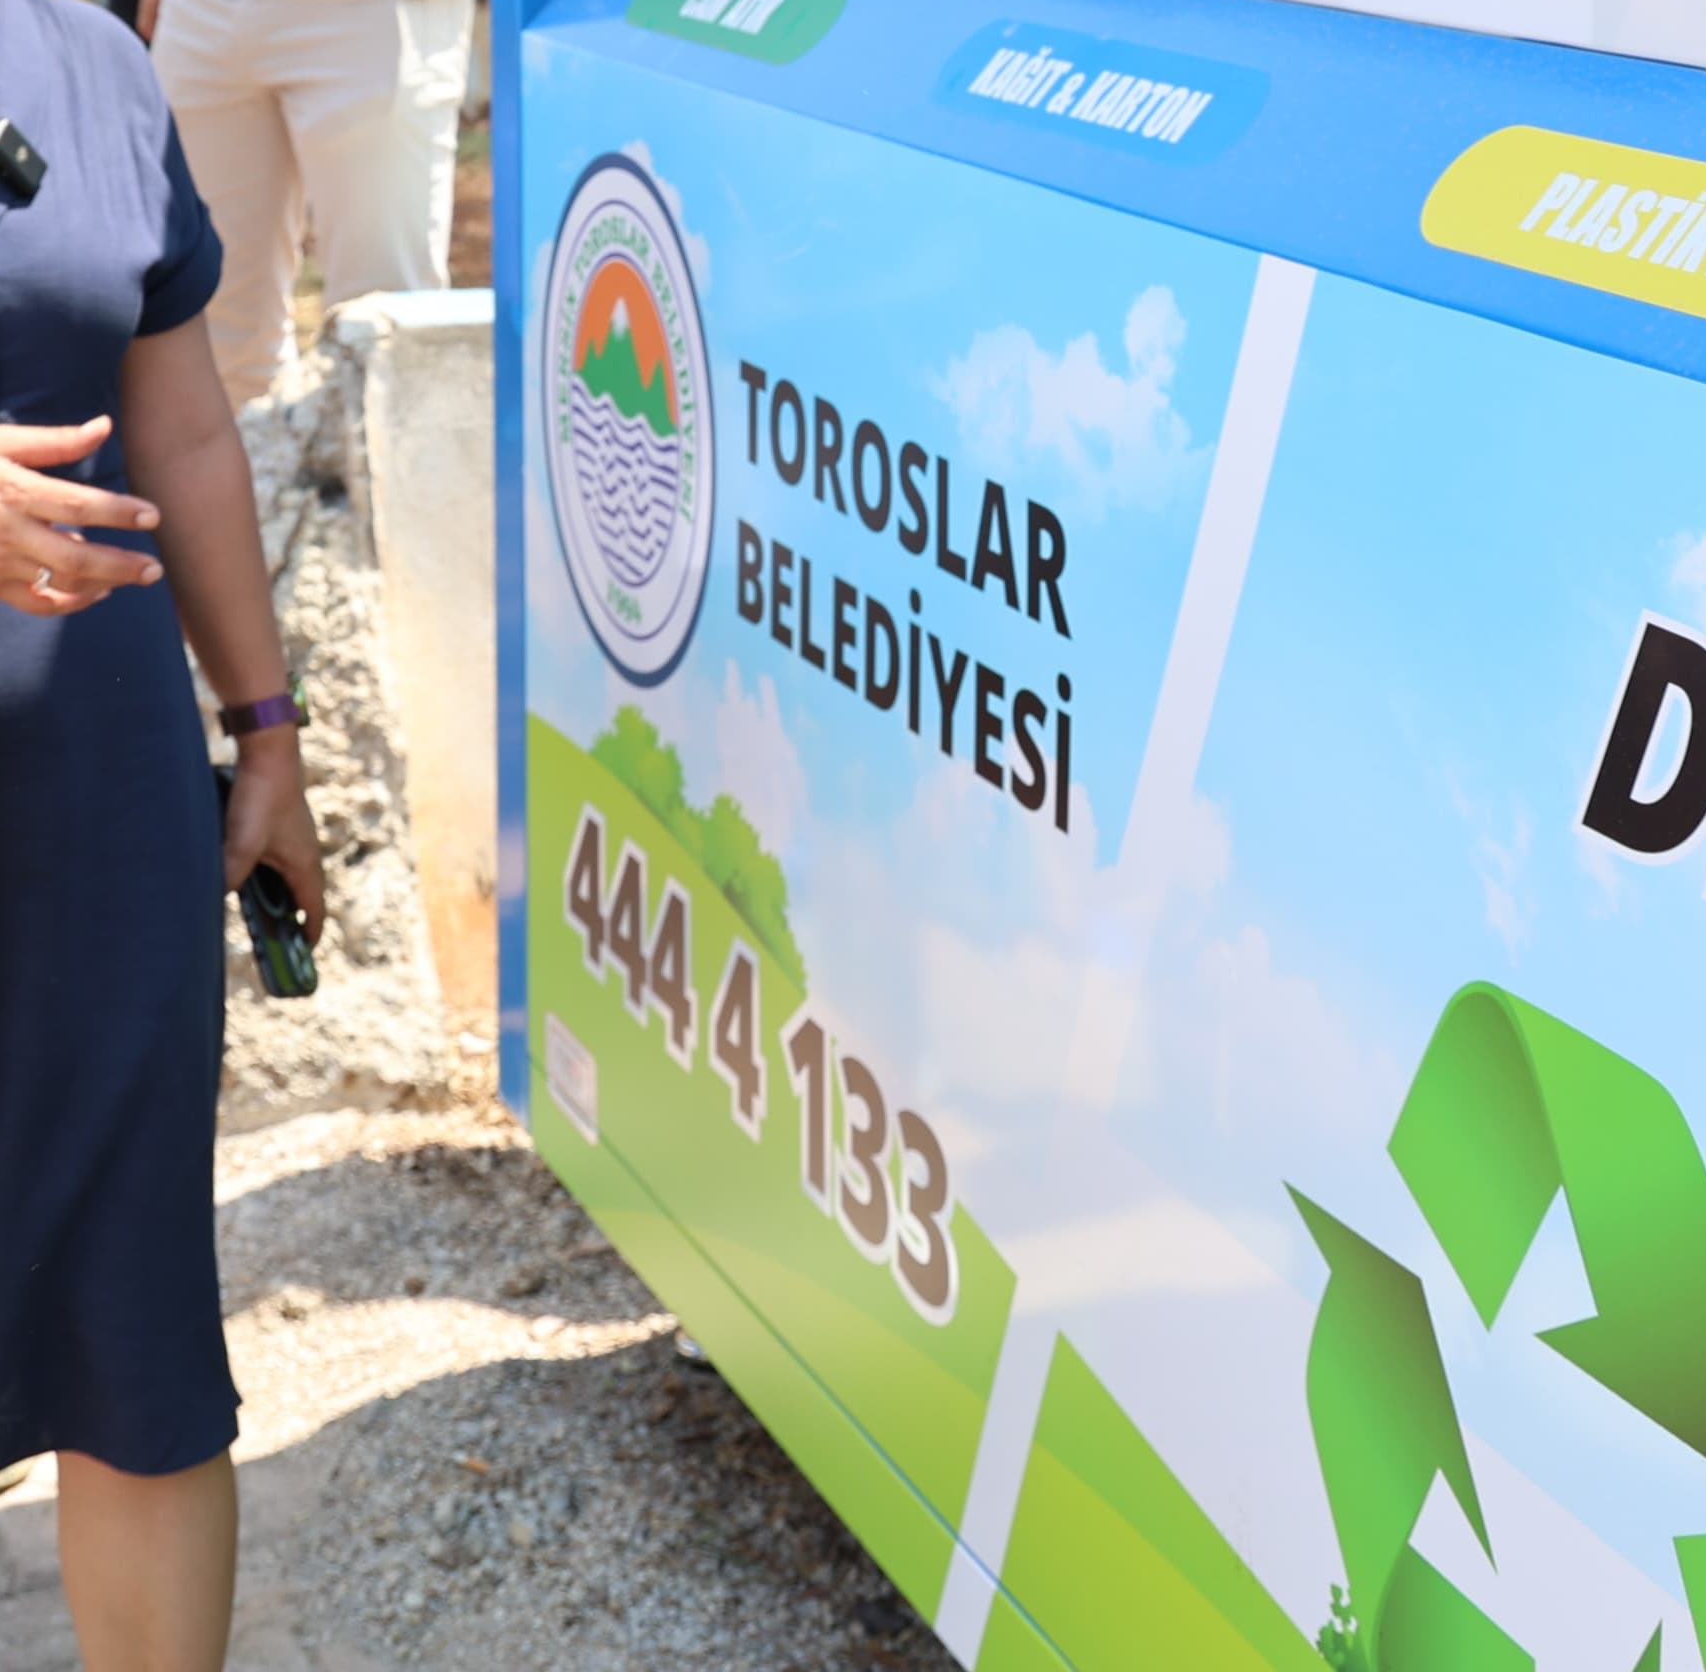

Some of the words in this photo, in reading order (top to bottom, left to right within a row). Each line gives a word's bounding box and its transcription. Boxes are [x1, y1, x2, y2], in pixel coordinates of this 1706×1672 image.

[967, 45, 1074, 109] KAĞIT
[1045, 71, 1087, 116] &
[1068, 69, 1214, 145] KARTON
[738, 358, 1073, 642] TOROSLAR
[737, 517, 1073, 836] BELEDİYESİ
[567, 813, 694, 1059] 444
[713, 946, 762, 1128] 4
[787, 1015, 951, 1311] 133
